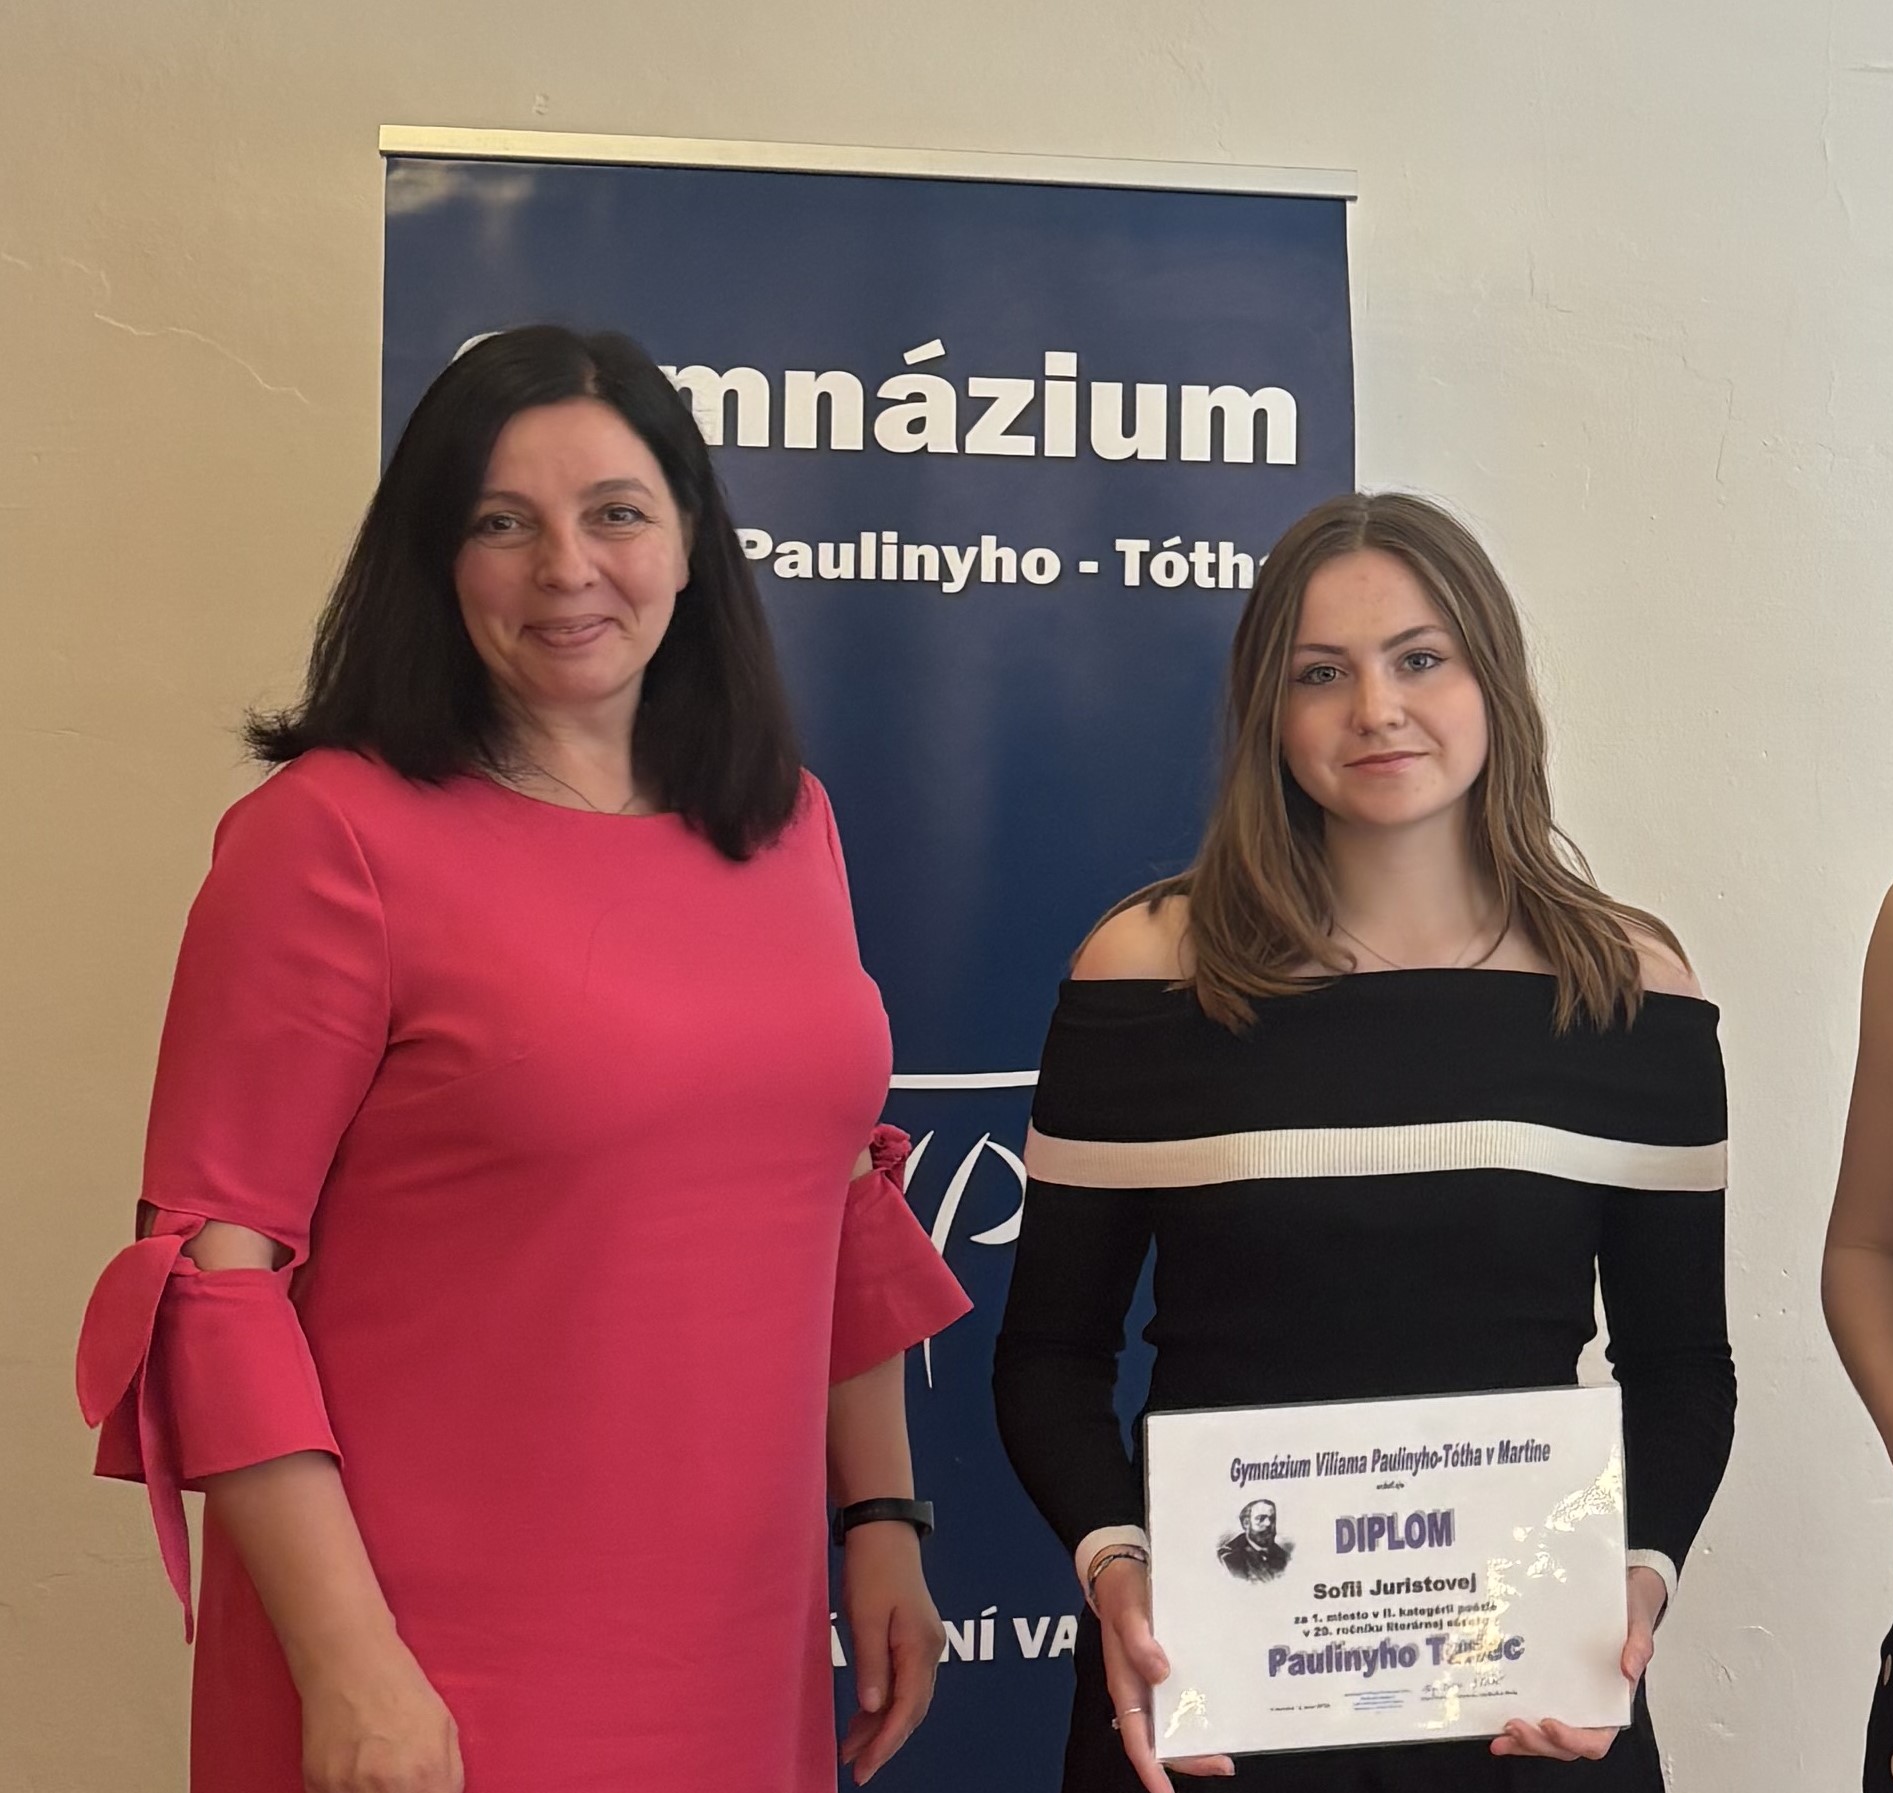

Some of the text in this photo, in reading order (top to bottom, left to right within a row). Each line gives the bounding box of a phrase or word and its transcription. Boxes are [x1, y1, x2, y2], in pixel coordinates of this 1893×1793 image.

[656, 339, 1298, 466] mnázium
[734, 528, 1061, 594] Paulinyho
[1115, 535, 1270, 589] Tóth
[1231, 1439, 1551, 1488] Gymnázium Viliama Paulinyho-Tótha v Martine
[1335, 1508, 1455, 1554] DIPLOM
[1370, 1572, 1477, 1596] Juristovej
[1302, 1629, 1310, 1637] v
[1372, 1611, 1379, 1619] v
[1268, 1635, 1420, 1678] Paulinyho
